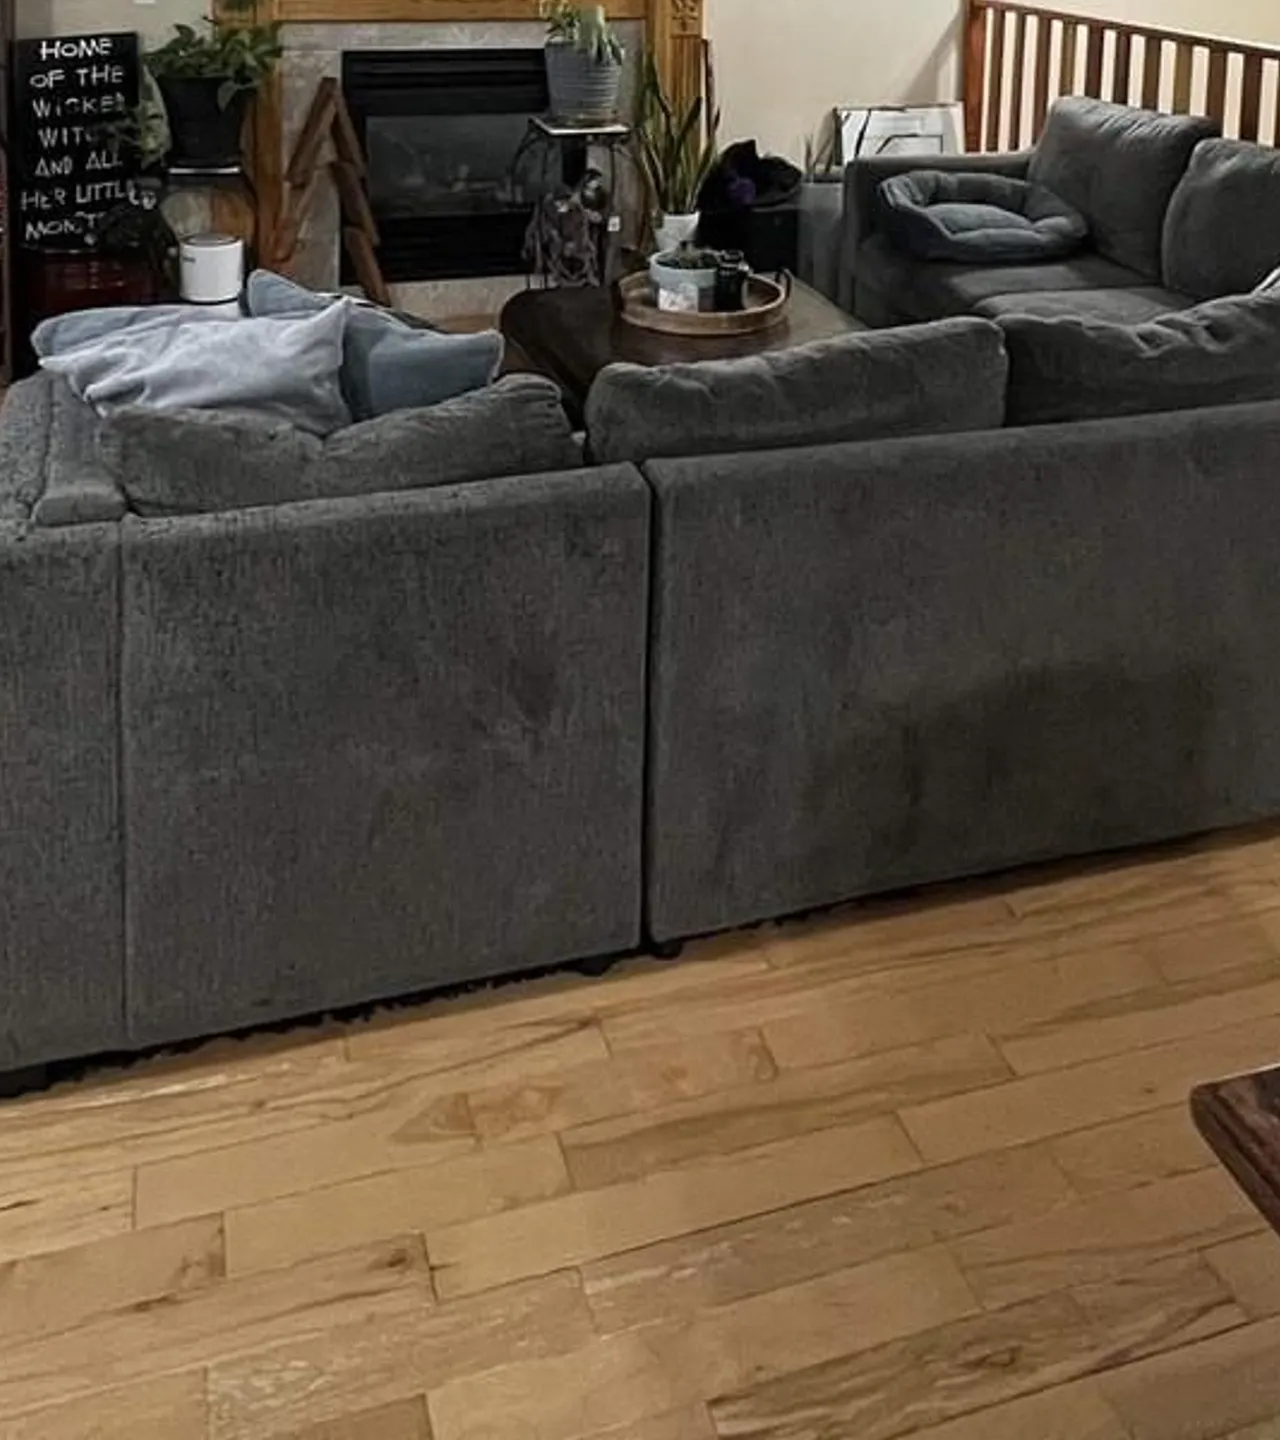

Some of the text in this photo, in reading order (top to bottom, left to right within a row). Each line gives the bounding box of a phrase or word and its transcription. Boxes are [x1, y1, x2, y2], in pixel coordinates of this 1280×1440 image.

[38, 37, 114, 61] HOME
[28, 63, 125, 90] OF THE
[33, 148, 124, 179] AND ALL
[19, 186, 68, 212] HER
